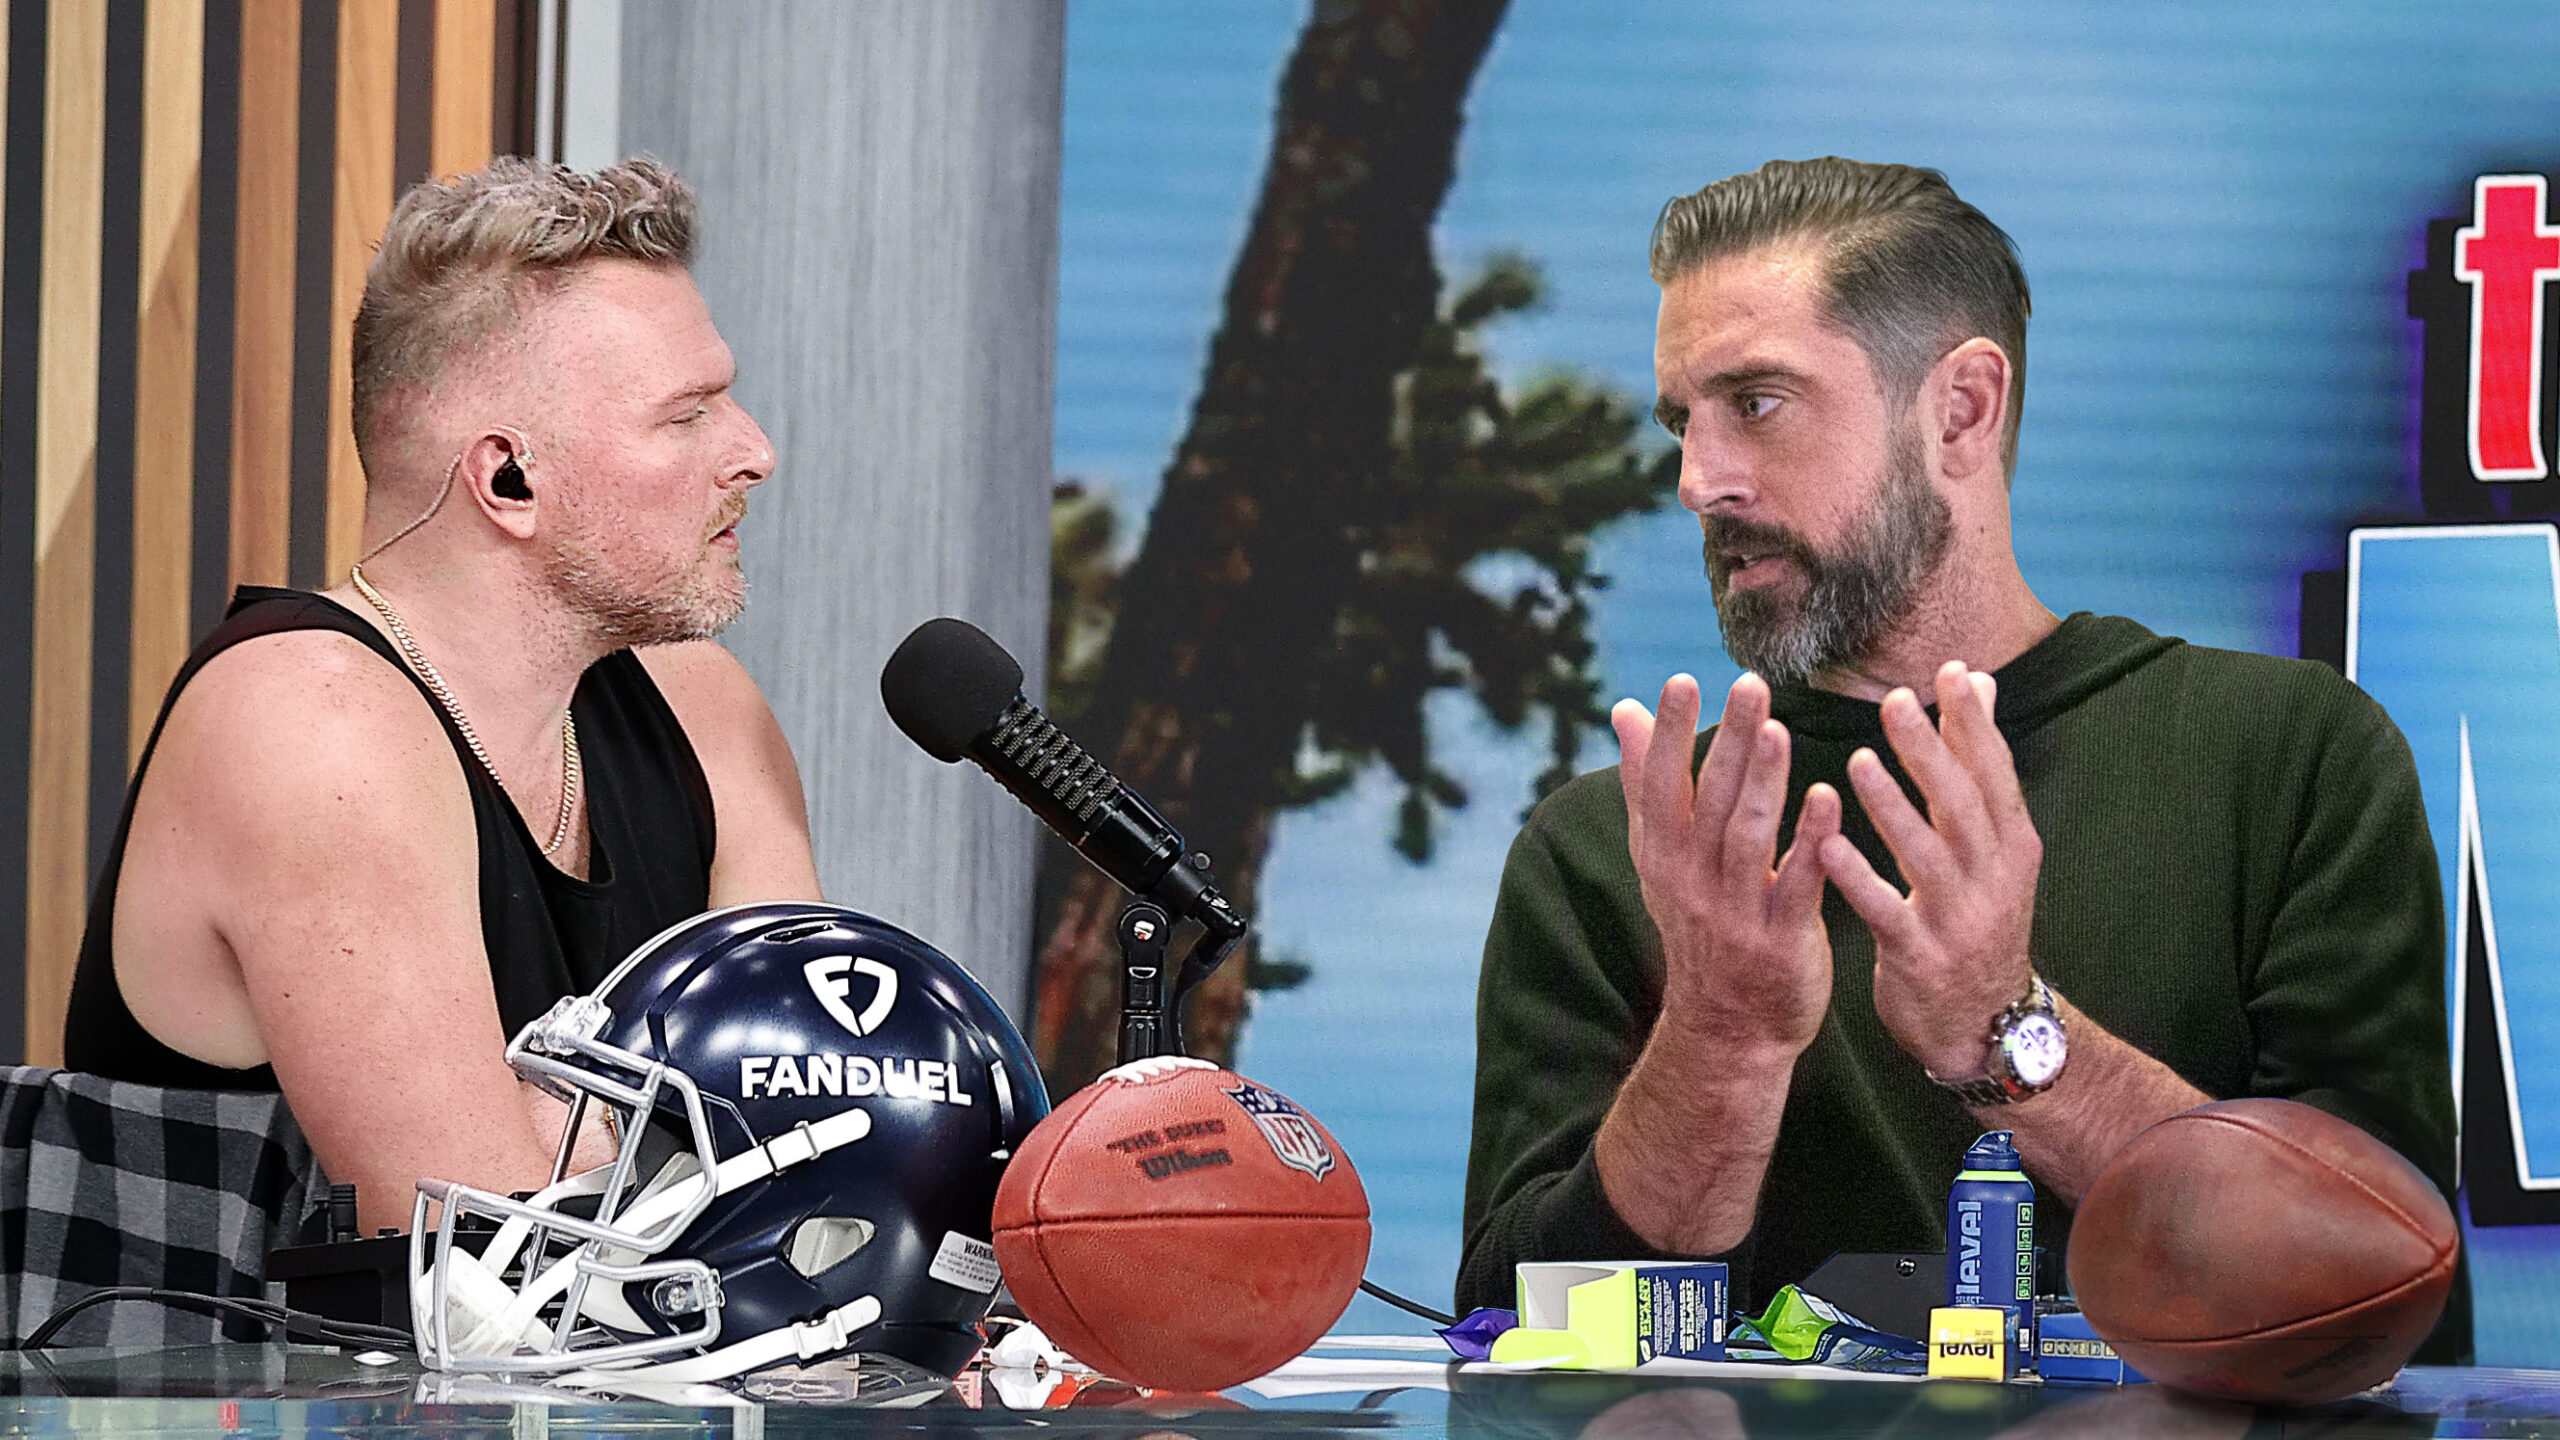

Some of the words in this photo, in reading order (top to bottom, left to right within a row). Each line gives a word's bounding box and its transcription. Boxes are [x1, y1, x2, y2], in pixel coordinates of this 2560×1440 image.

[740, 1052, 972, 1106] FANDUEL
[1263, 1114, 1326, 1164] NFL
[1956, 1201, 1982, 1295] level
[1940, 1343, 1994, 1359] level
